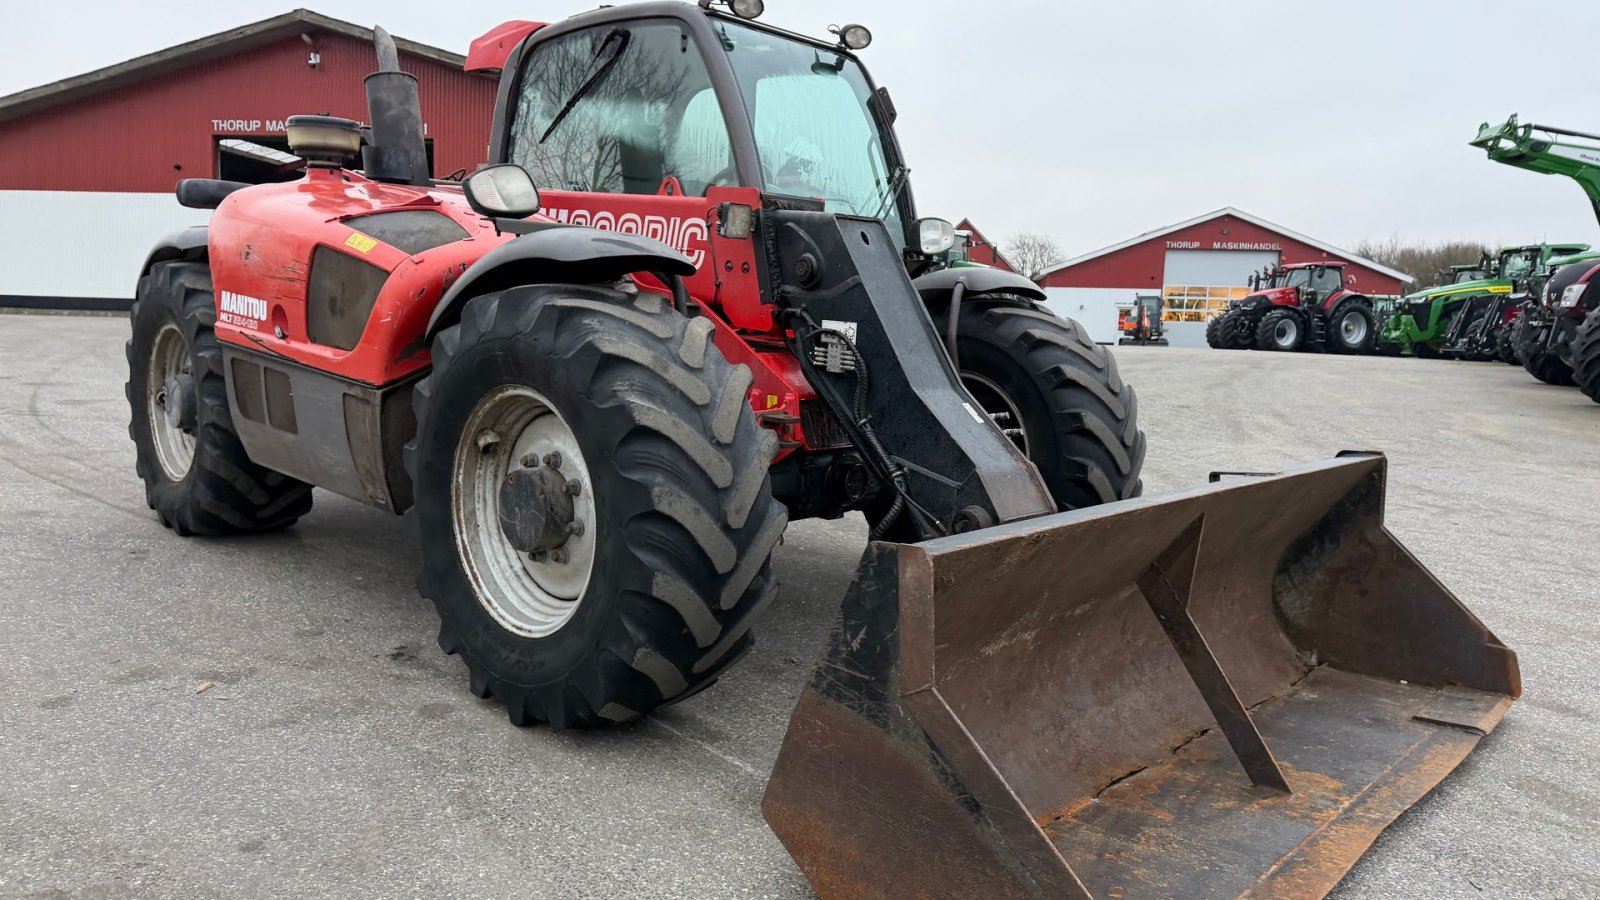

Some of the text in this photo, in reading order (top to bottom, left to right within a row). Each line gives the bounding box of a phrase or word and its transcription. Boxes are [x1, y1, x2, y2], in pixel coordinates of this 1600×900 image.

[211, 119, 261, 132] THORUP
[1166, 241, 1281, 250] THORUP MASKINHANDEL
[220, 290, 268, 321] MANITOU
[220, 311, 233, 323] MLT
